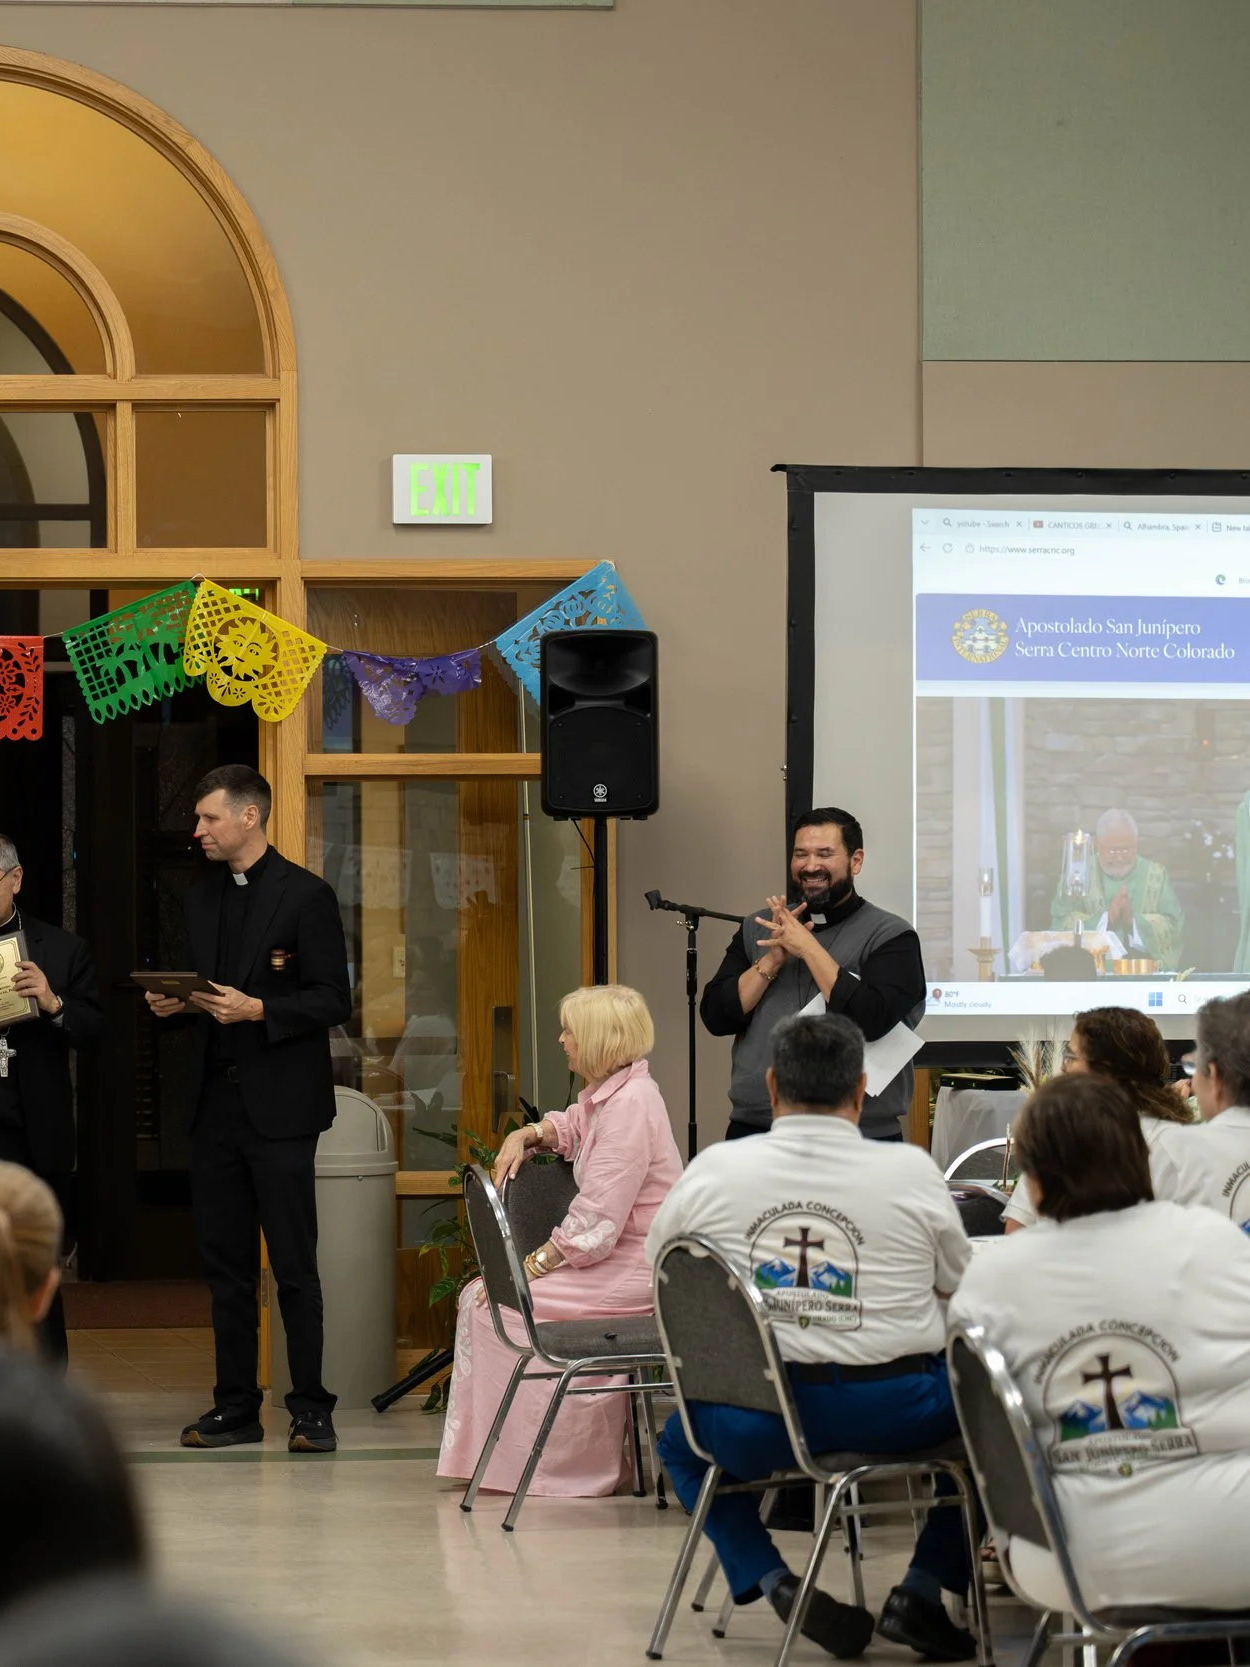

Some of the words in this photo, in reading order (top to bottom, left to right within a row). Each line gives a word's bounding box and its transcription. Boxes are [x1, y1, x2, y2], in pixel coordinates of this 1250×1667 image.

[410, 462, 480, 517] EXIT
[987, 520, 1010, 529] Search
[1227, 524, 1241, 532] New
[1015, 617, 1102, 637] Apostolado
[1106, 618, 1133, 634] San
[1135, 618, 1201, 639] Junípero
[1015, 641, 1054, 657] Serra
[1056, 641, 1112, 658] Centro
[1116, 642, 1159, 658] Norte
[1163, 641, 1235, 659] Colorado
[944, 1001, 967, 1009] Mostly
[968, 1001, 992, 1009] cloudy
[806, 1200, 866, 1246] CONCEPCION
